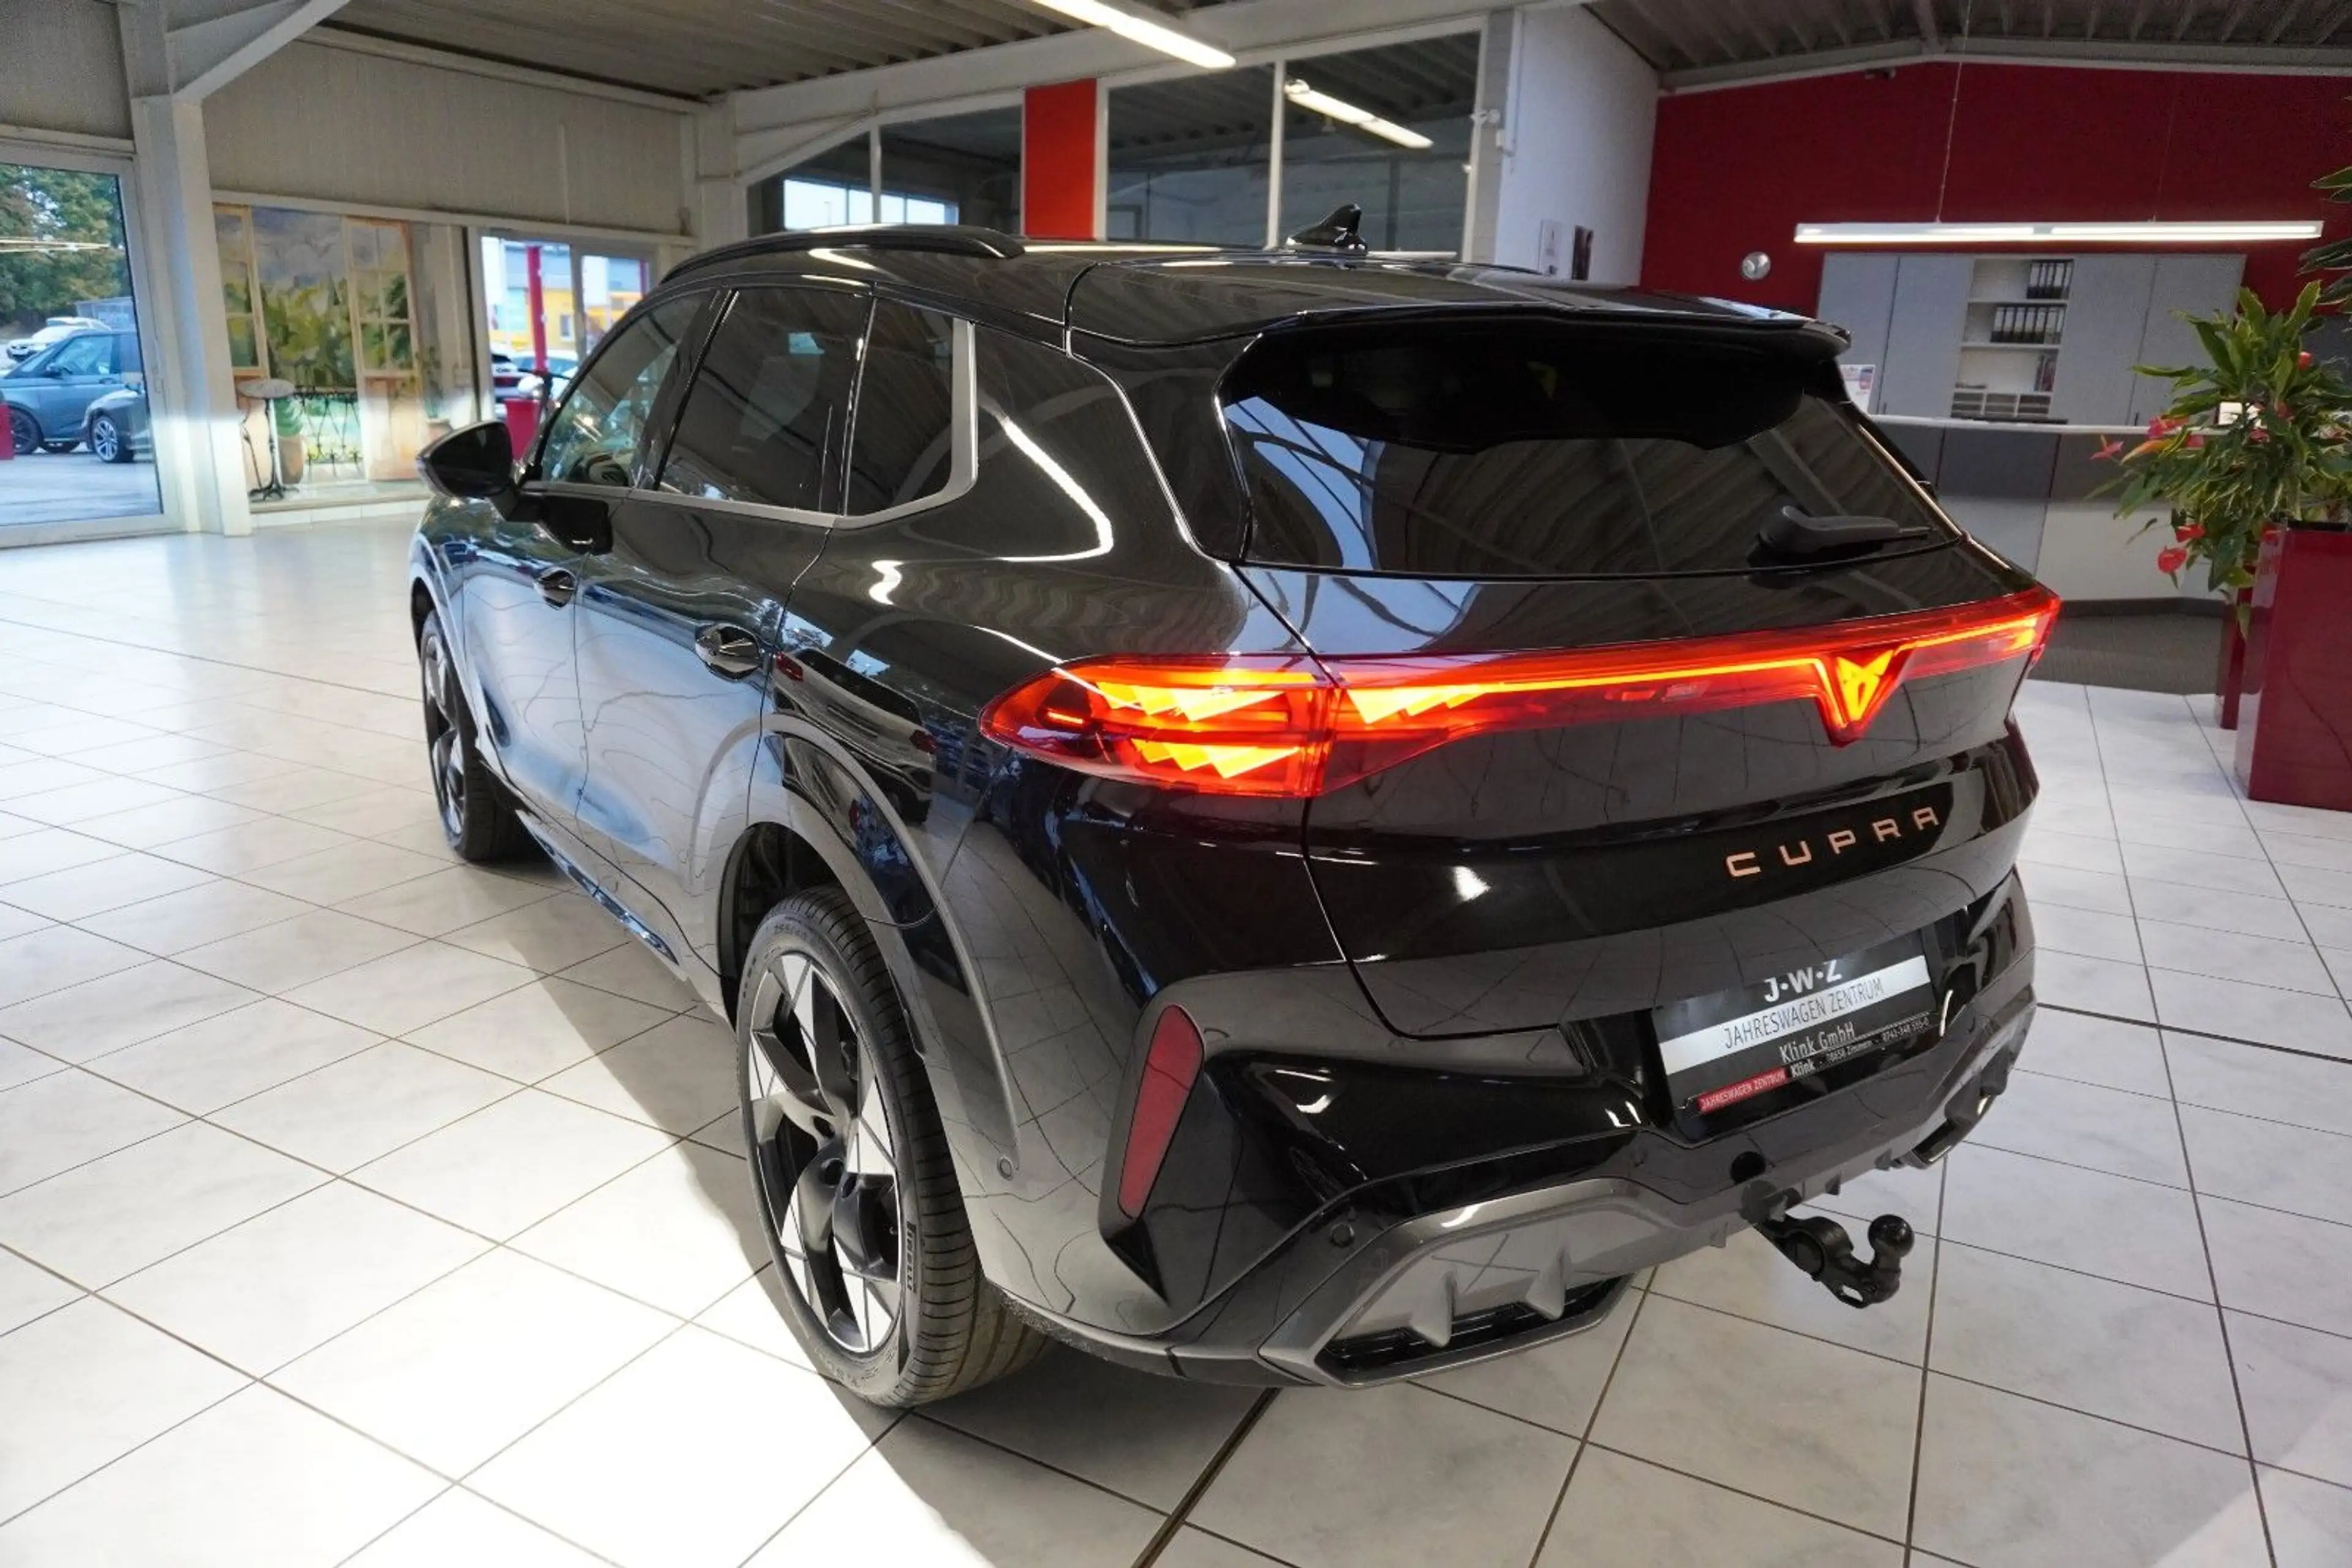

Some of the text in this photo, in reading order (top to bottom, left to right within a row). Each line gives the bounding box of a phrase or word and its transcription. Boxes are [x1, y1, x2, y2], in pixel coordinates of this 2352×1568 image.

[1725, 806, 1939, 877] CUPRA
[1724, 977, 1884, 1049] JAHRESWAGEN ZENTRUM
[1779, 1020, 1856, 1064] Klink GmbH
